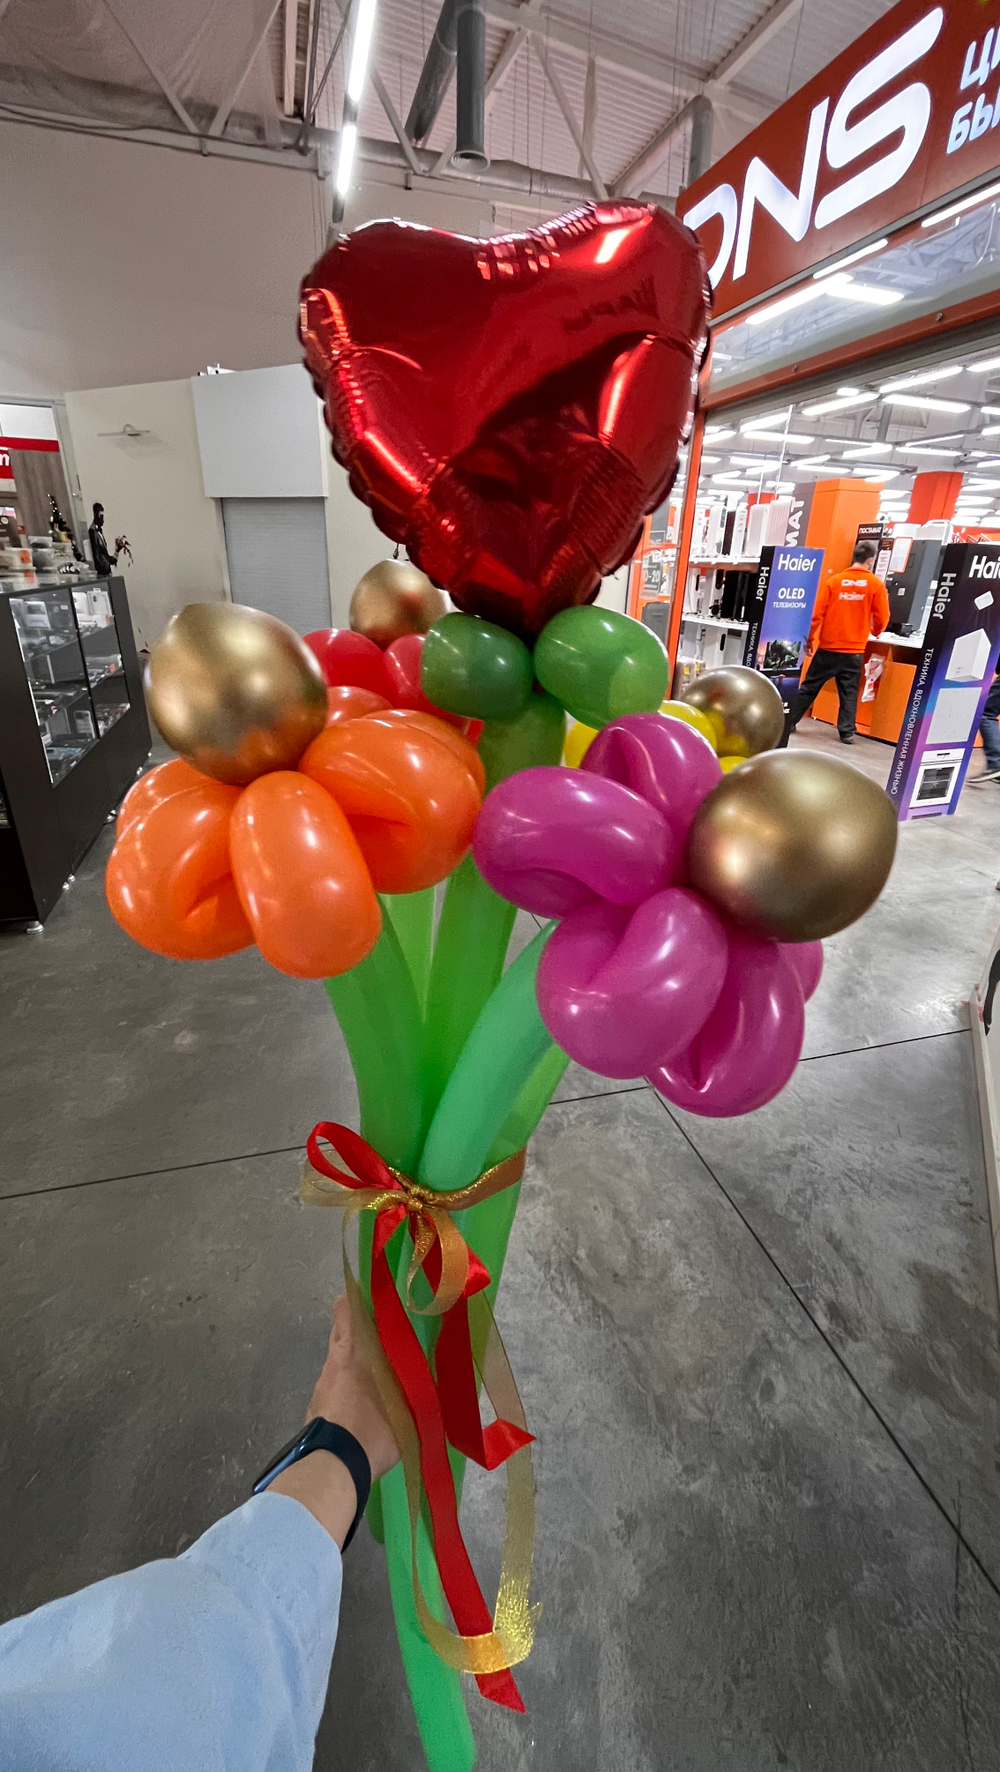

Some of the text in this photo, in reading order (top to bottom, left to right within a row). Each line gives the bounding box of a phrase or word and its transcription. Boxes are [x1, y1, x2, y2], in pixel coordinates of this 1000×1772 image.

[778, 553, 817, 572] Haier
[968, 555, 1000, 579] Hai
[756, 566, 770, 602] Haier
[778, 587, 806, 600] OLED
[841, 579, 868, 587] DNS
[773, 601, 807, 609] ТЕЛЕВИЗОРЫ
[839, 592, 866, 601] Haier
[932, 572, 957, 620] Haier
[900, 689, 924, 760] ВДОХНОВЛЕННАЯ
[890, 760, 904, 795] ЖИЗНЬЮ
